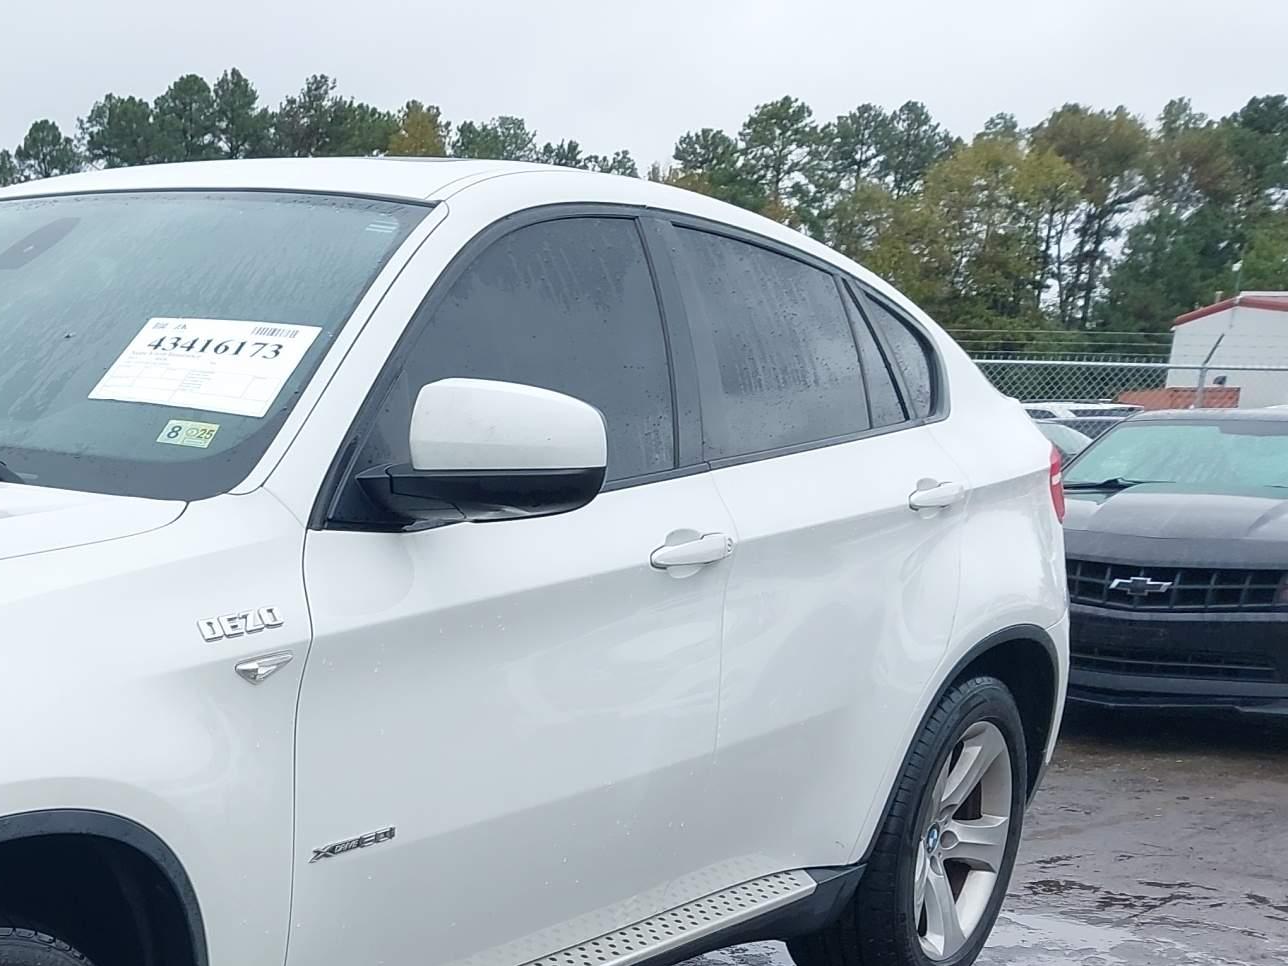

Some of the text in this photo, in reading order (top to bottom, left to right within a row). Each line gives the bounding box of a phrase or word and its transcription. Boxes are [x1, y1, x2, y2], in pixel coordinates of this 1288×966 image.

[147, 336, 283, 360] 43416173
[167, 425, 215, 440] 8 25
